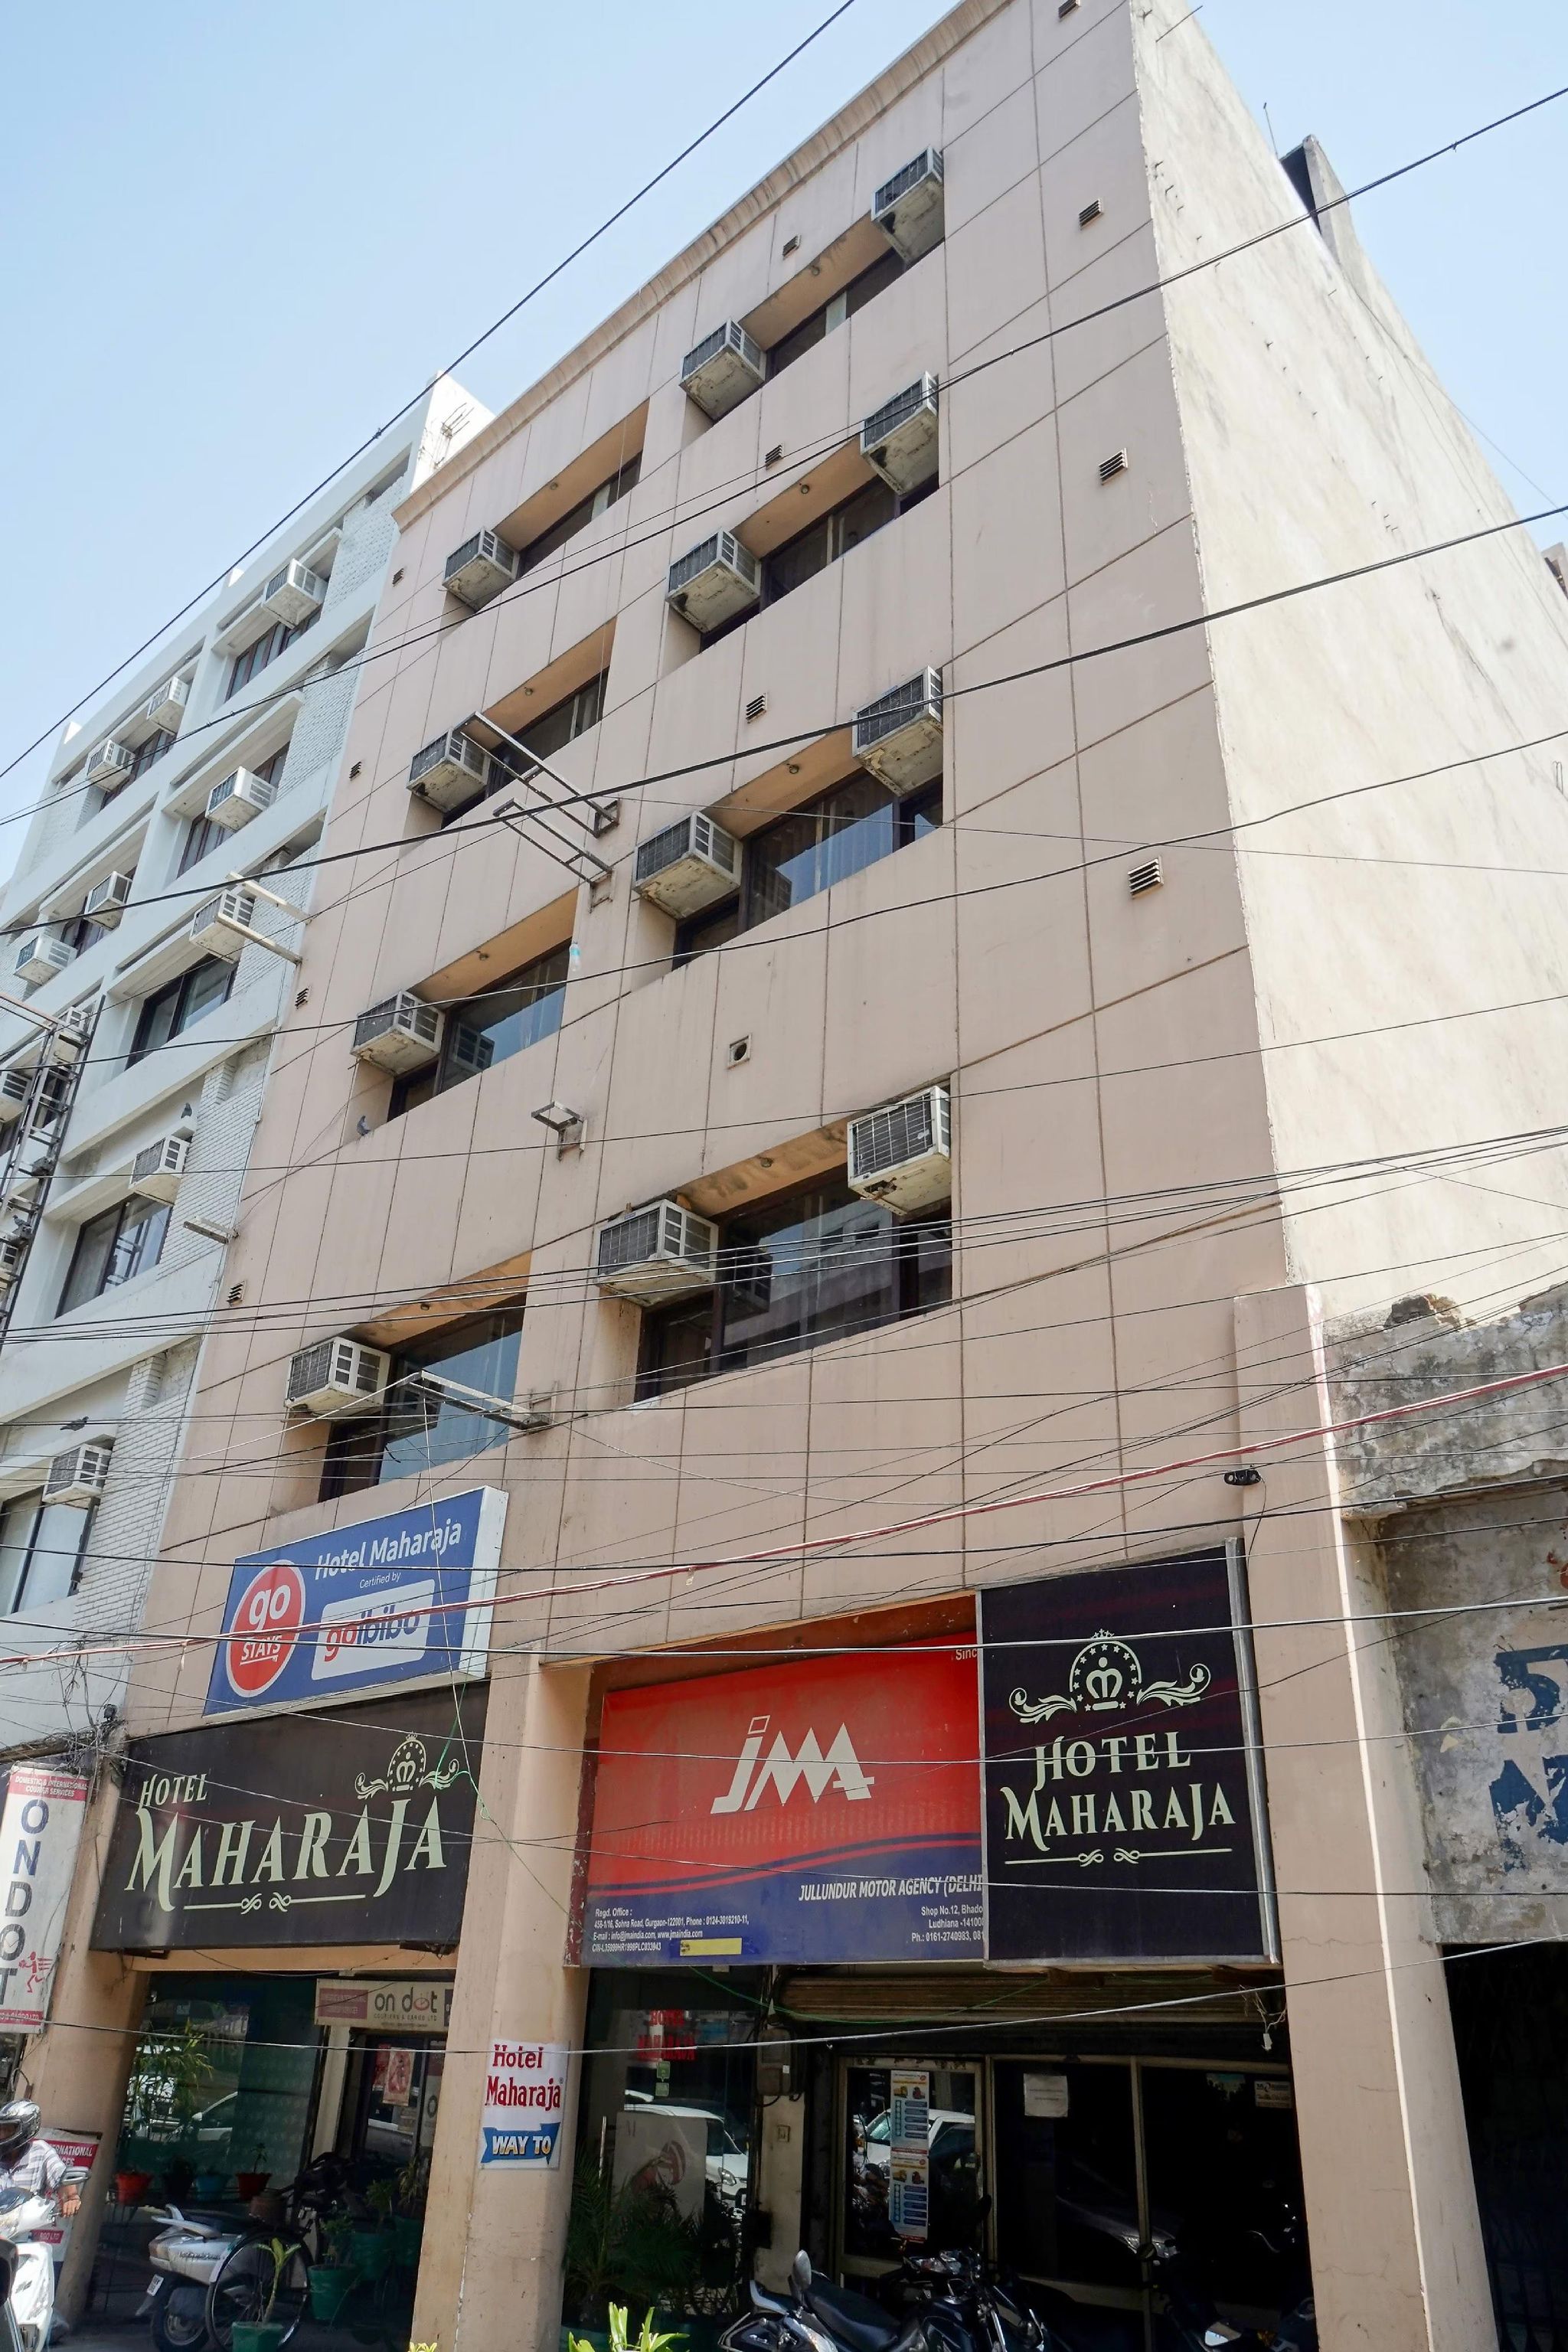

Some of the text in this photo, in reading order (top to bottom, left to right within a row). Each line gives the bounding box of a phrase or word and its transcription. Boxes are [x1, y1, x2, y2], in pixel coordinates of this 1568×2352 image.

[315, 1519, 462, 1580] Hotel Maharaja
[359, 1572, 401, 1589] Certified by
[249, 1584, 290, 1631] go
[325, 1605, 420, 1661] goibibo
[240, 1635, 282, 1660] STAYS
[1034, 1731, 1191, 1791] HOTEL
[15, 1775, 42, 1786] DOMESTIC
[47, 1779, 87, 1791] INTERNATIONAL
[26, 1785, 75, 1797] COURIER SERVICES
[139, 1773, 208, 1813] HOTEL
[1000, 1782, 1236, 1851] MAHARAJA
[124, 1796, 446, 1912] MAHARAJA
[799, 1883, 857, 1901] JULLUNDUR
[859, 1880, 896, 1897] MOTOR
[898, 1878, 940, 1896] AGENCY
[596, 1908, 611, 1919] Regd.
[612, 1907, 629, 1916] Office
[615, 1919, 629, 1929] Sohna
[631, 1919, 644, 1929] Road,
[686, 1916, 702, 1926] Phone
[921, 1904, 983, 1917] Shop No.12, Bhado
[929, 1919, 959, 1929] Ludhiana
[926, 1931, 971, 1942] 0161-2740983,
[374, 1993, 394, 2011] on
[401, 1987, 437, 2014] dot
[492, 2044, 544, 2068] Hotel
[485, 2075, 560, 2112] Maharaja
[492, 2135, 551, 2155] WAY TO
